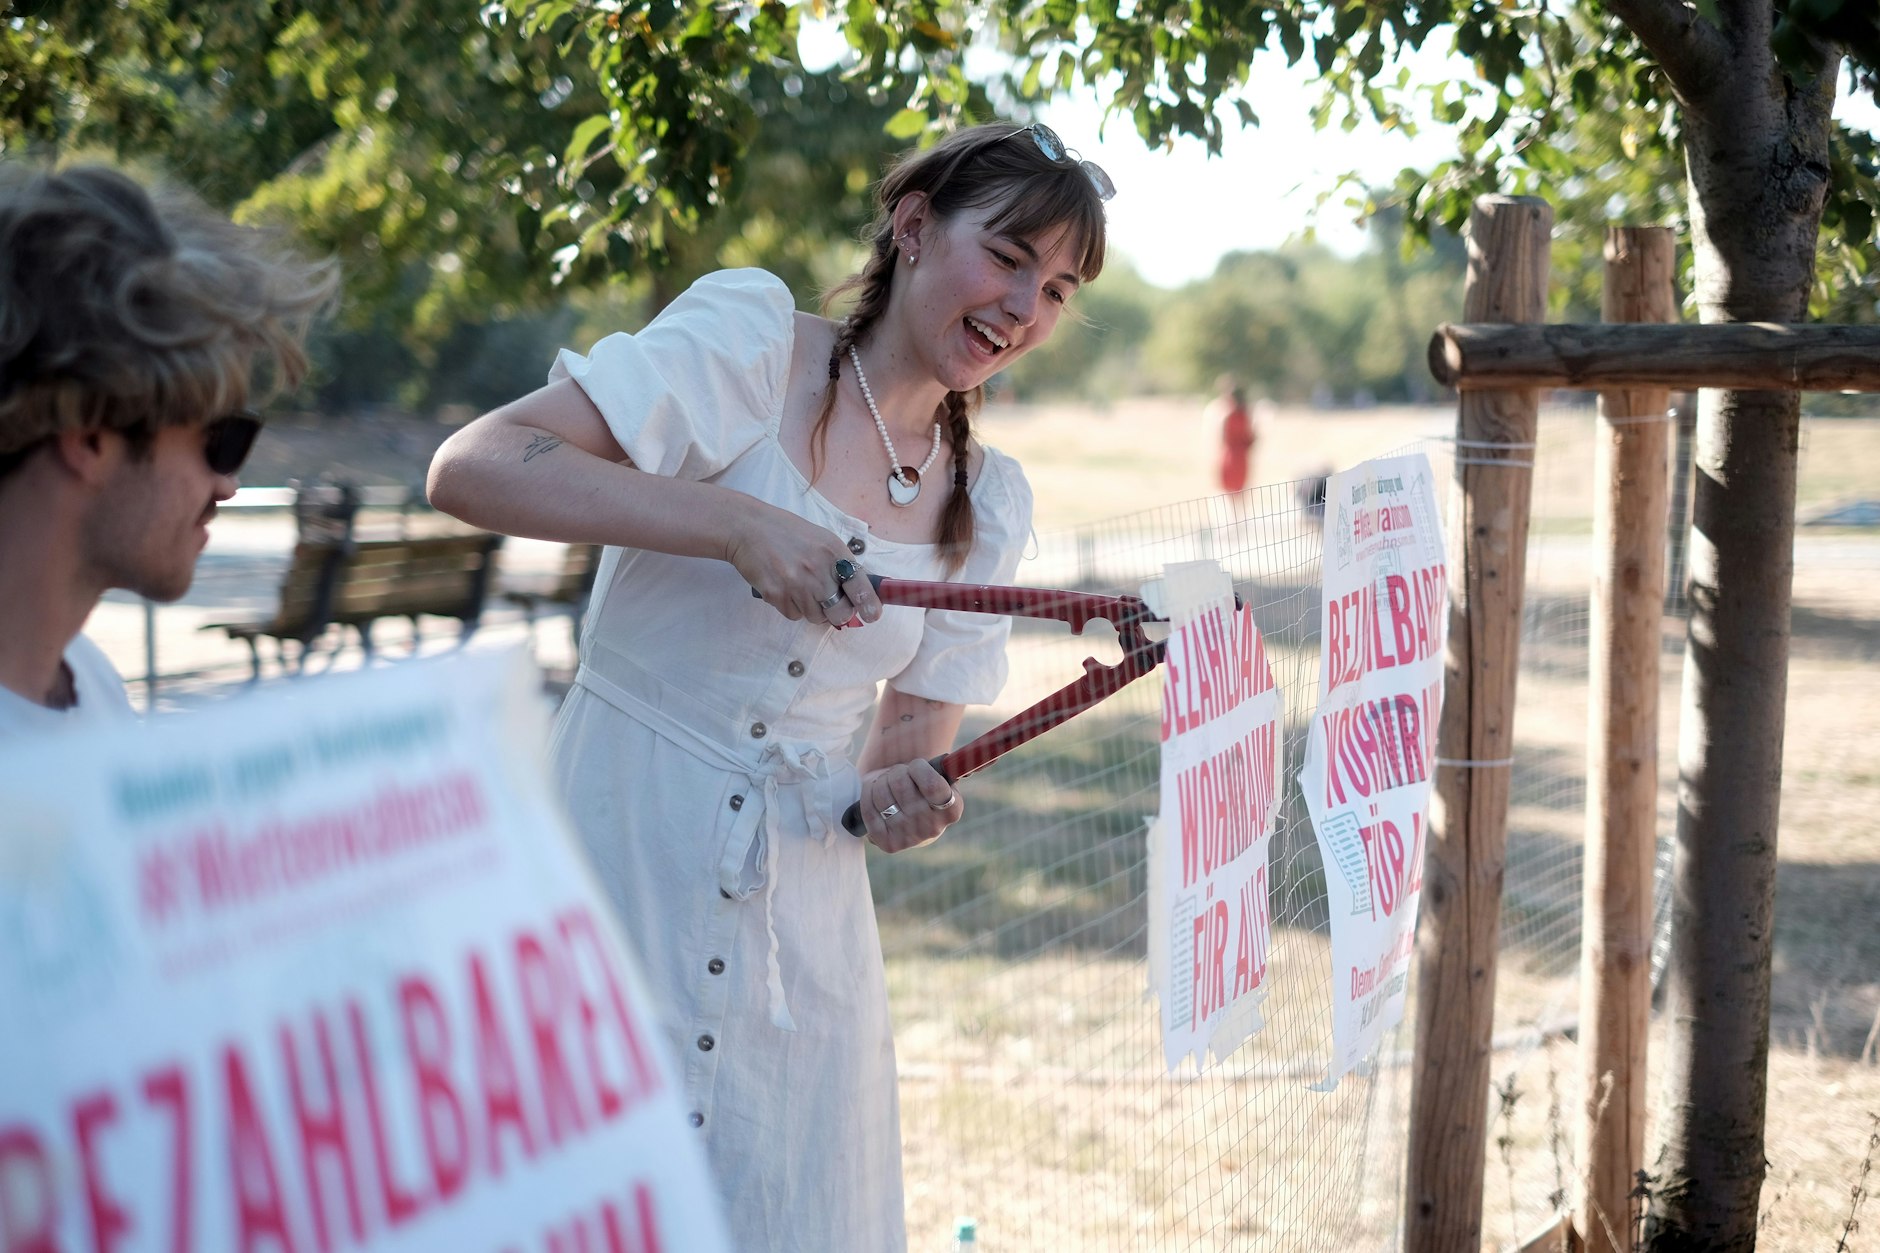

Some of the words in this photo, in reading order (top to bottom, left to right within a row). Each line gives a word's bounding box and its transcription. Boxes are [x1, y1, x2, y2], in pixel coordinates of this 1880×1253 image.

[1161, 597, 1274, 742] EZAHLBA
[1328, 563, 1447, 695] BEZLBARE
[1177, 720, 1275, 889] WOHNRAUM
[1322, 679, 1440, 809] WOHNR
[1358, 803, 1404, 921] FÜR
[1191, 882, 1229, 1033] FÜR
